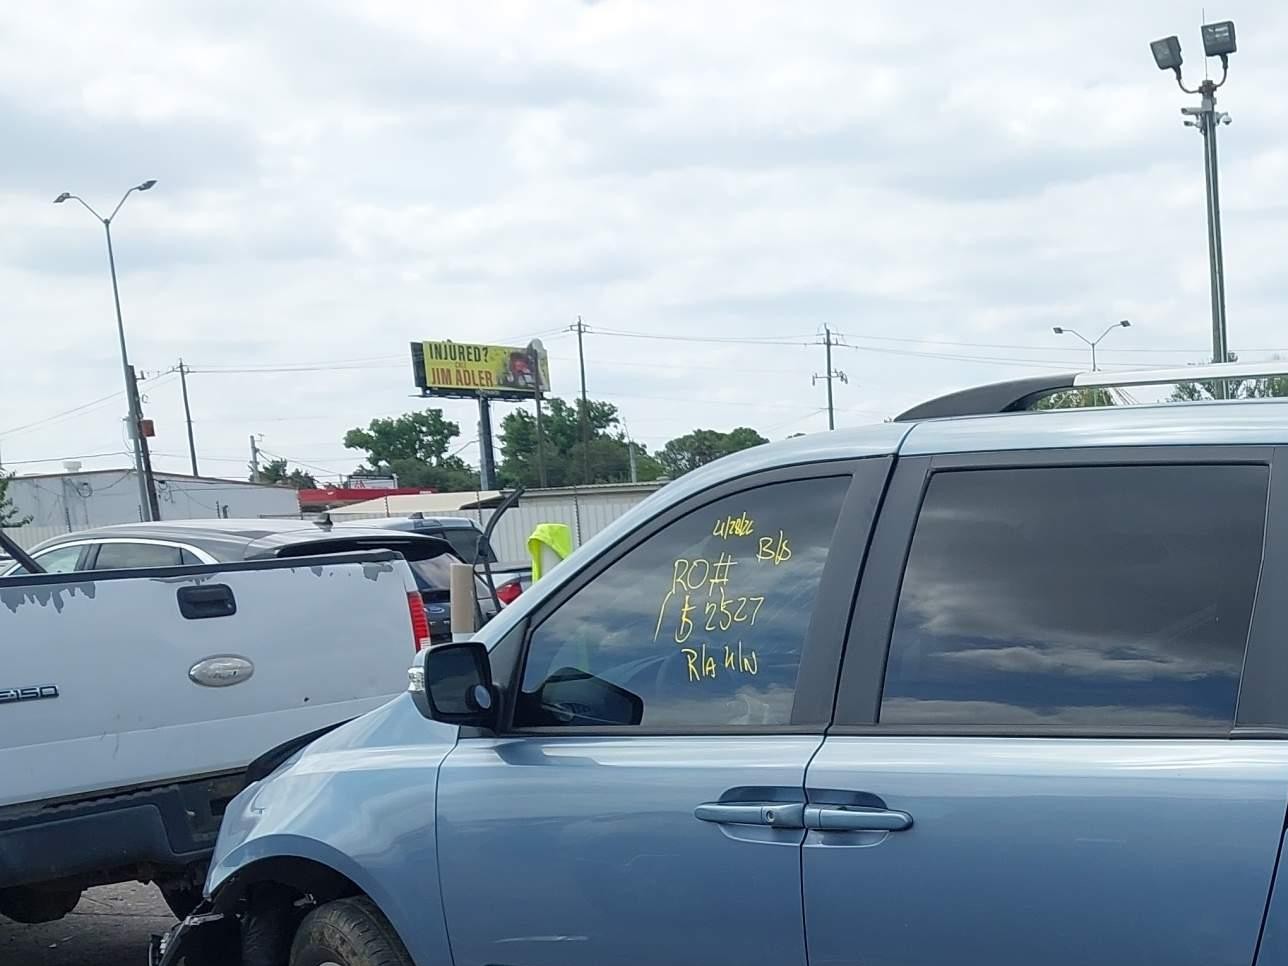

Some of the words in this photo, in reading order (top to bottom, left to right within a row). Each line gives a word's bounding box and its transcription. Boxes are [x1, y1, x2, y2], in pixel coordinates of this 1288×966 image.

[428, 343, 489, 363] INJURED?
[431, 367, 453, 386] JIM
[455, 368, 494, 388] ADLER
